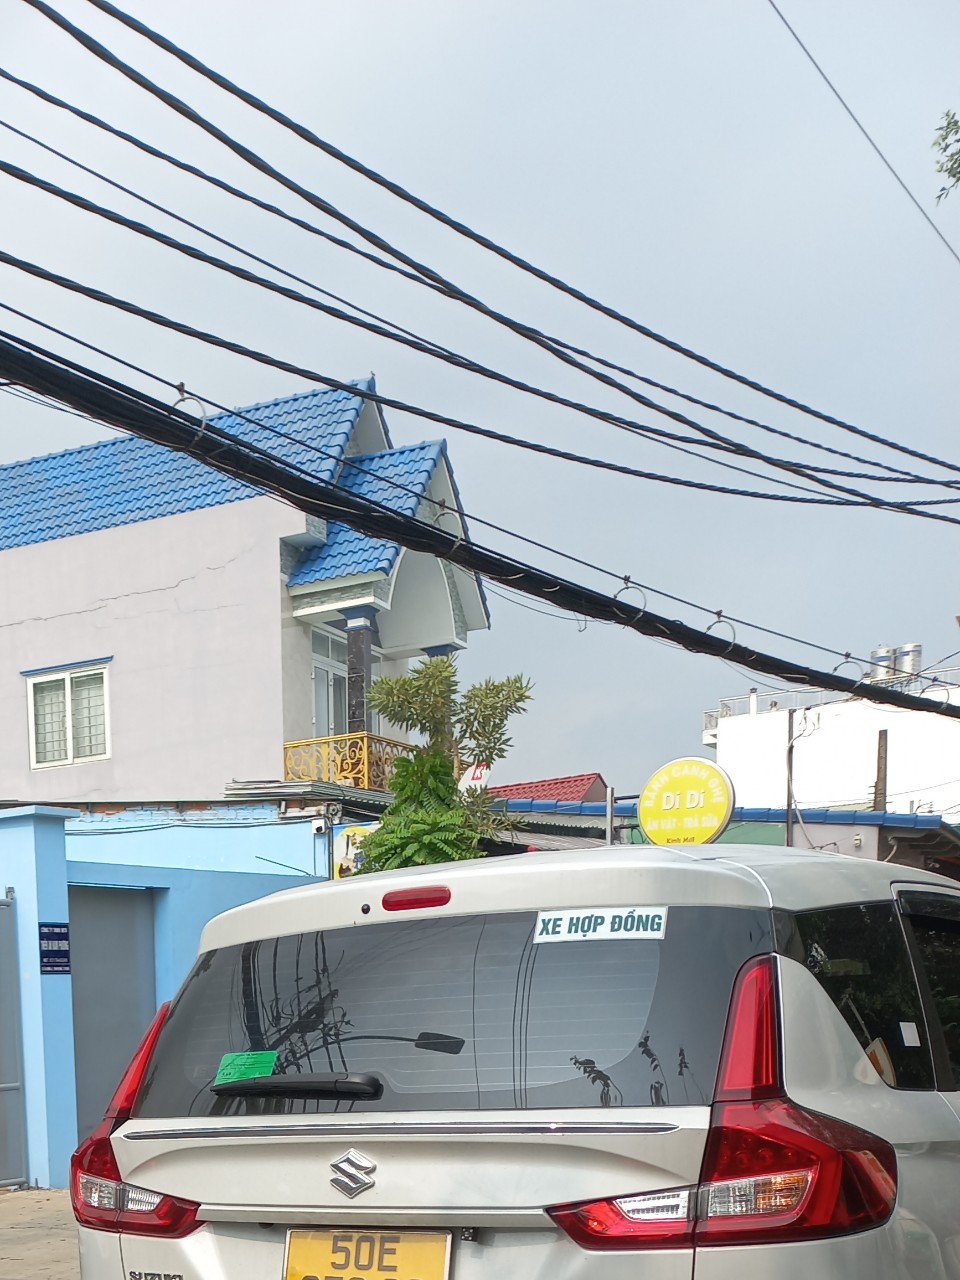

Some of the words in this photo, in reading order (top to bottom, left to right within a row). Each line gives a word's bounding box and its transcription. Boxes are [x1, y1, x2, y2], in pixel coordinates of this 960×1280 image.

[538, 917, 563, 936] XE
[567, 914, 606, 938] HỢP
[331, 1235, 401, 1272] 50E
